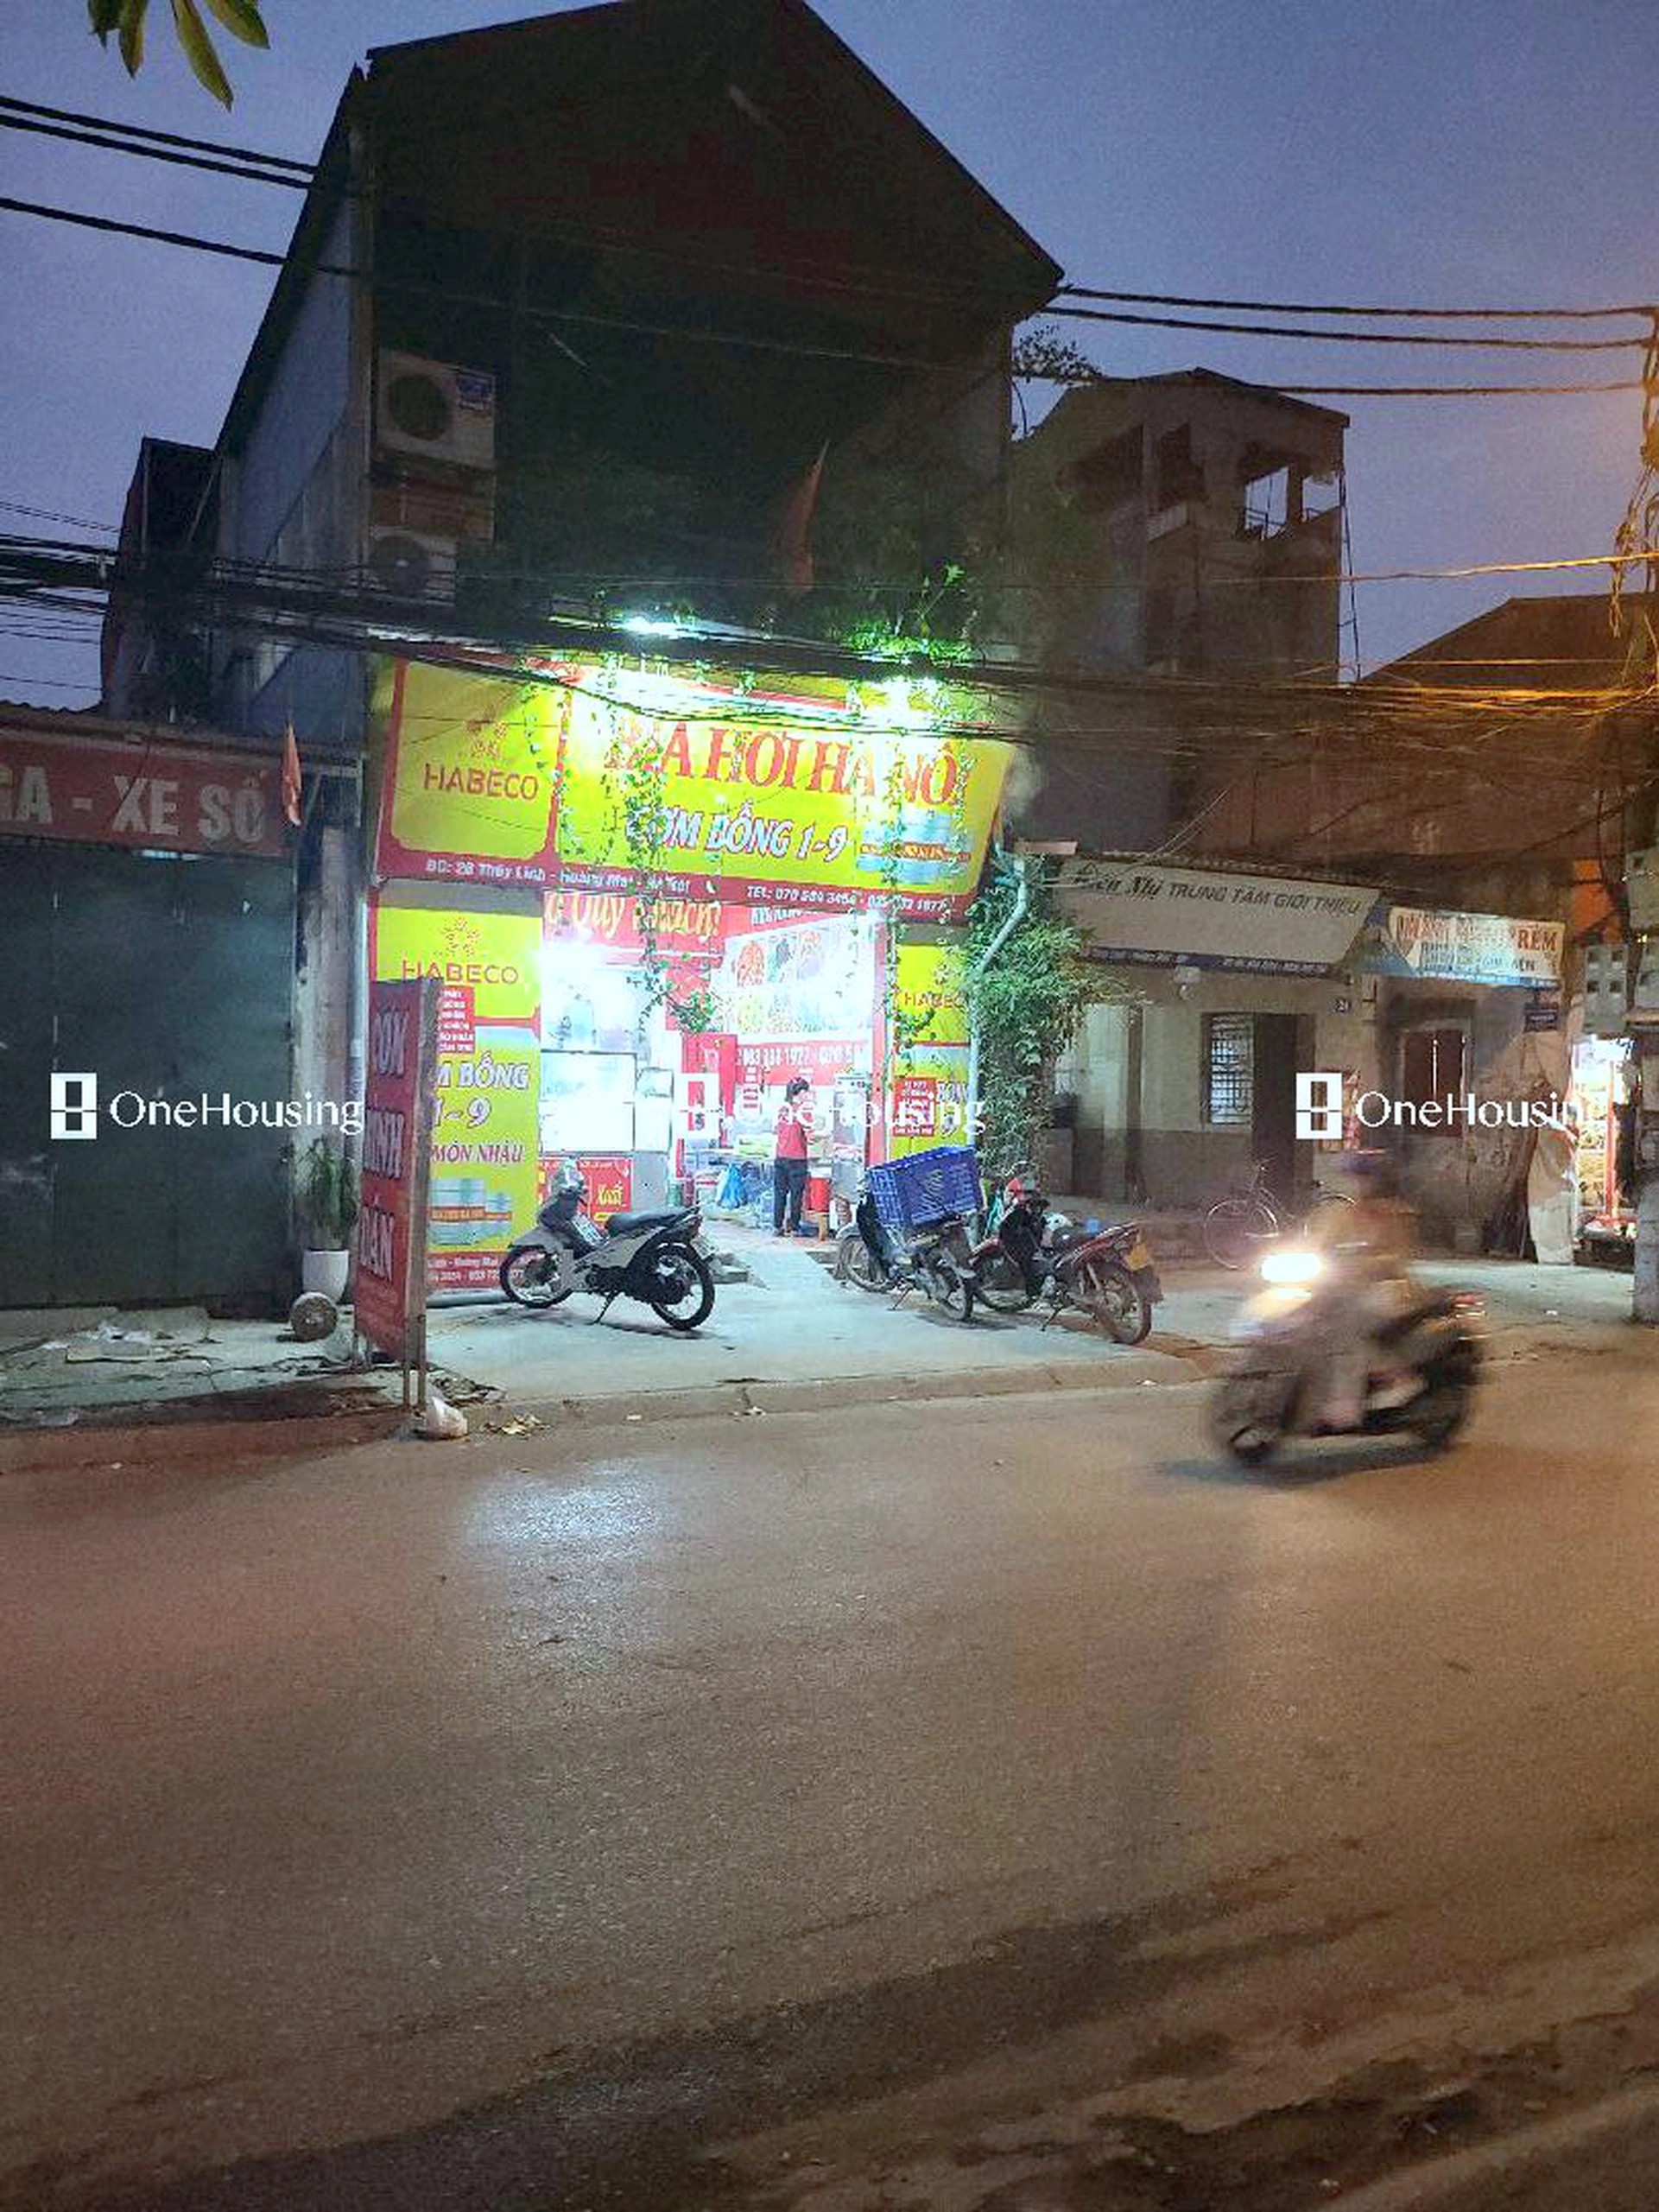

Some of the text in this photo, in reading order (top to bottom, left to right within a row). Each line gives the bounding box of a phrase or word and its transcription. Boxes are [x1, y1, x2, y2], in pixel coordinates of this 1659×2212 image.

[423, 763, 539, 801] HABECO
[111, 776, 180, 836] XE
[197, 769, 268, 843] SỐ
[795, 821, 849, 863] 1-9
[747, 884, 772, 900] TEL:
[1168, 883, 1228, 902] TRUNG
[402, 959, 519, 985] HABECO
[904, 992, 969, 1010] HABEC
